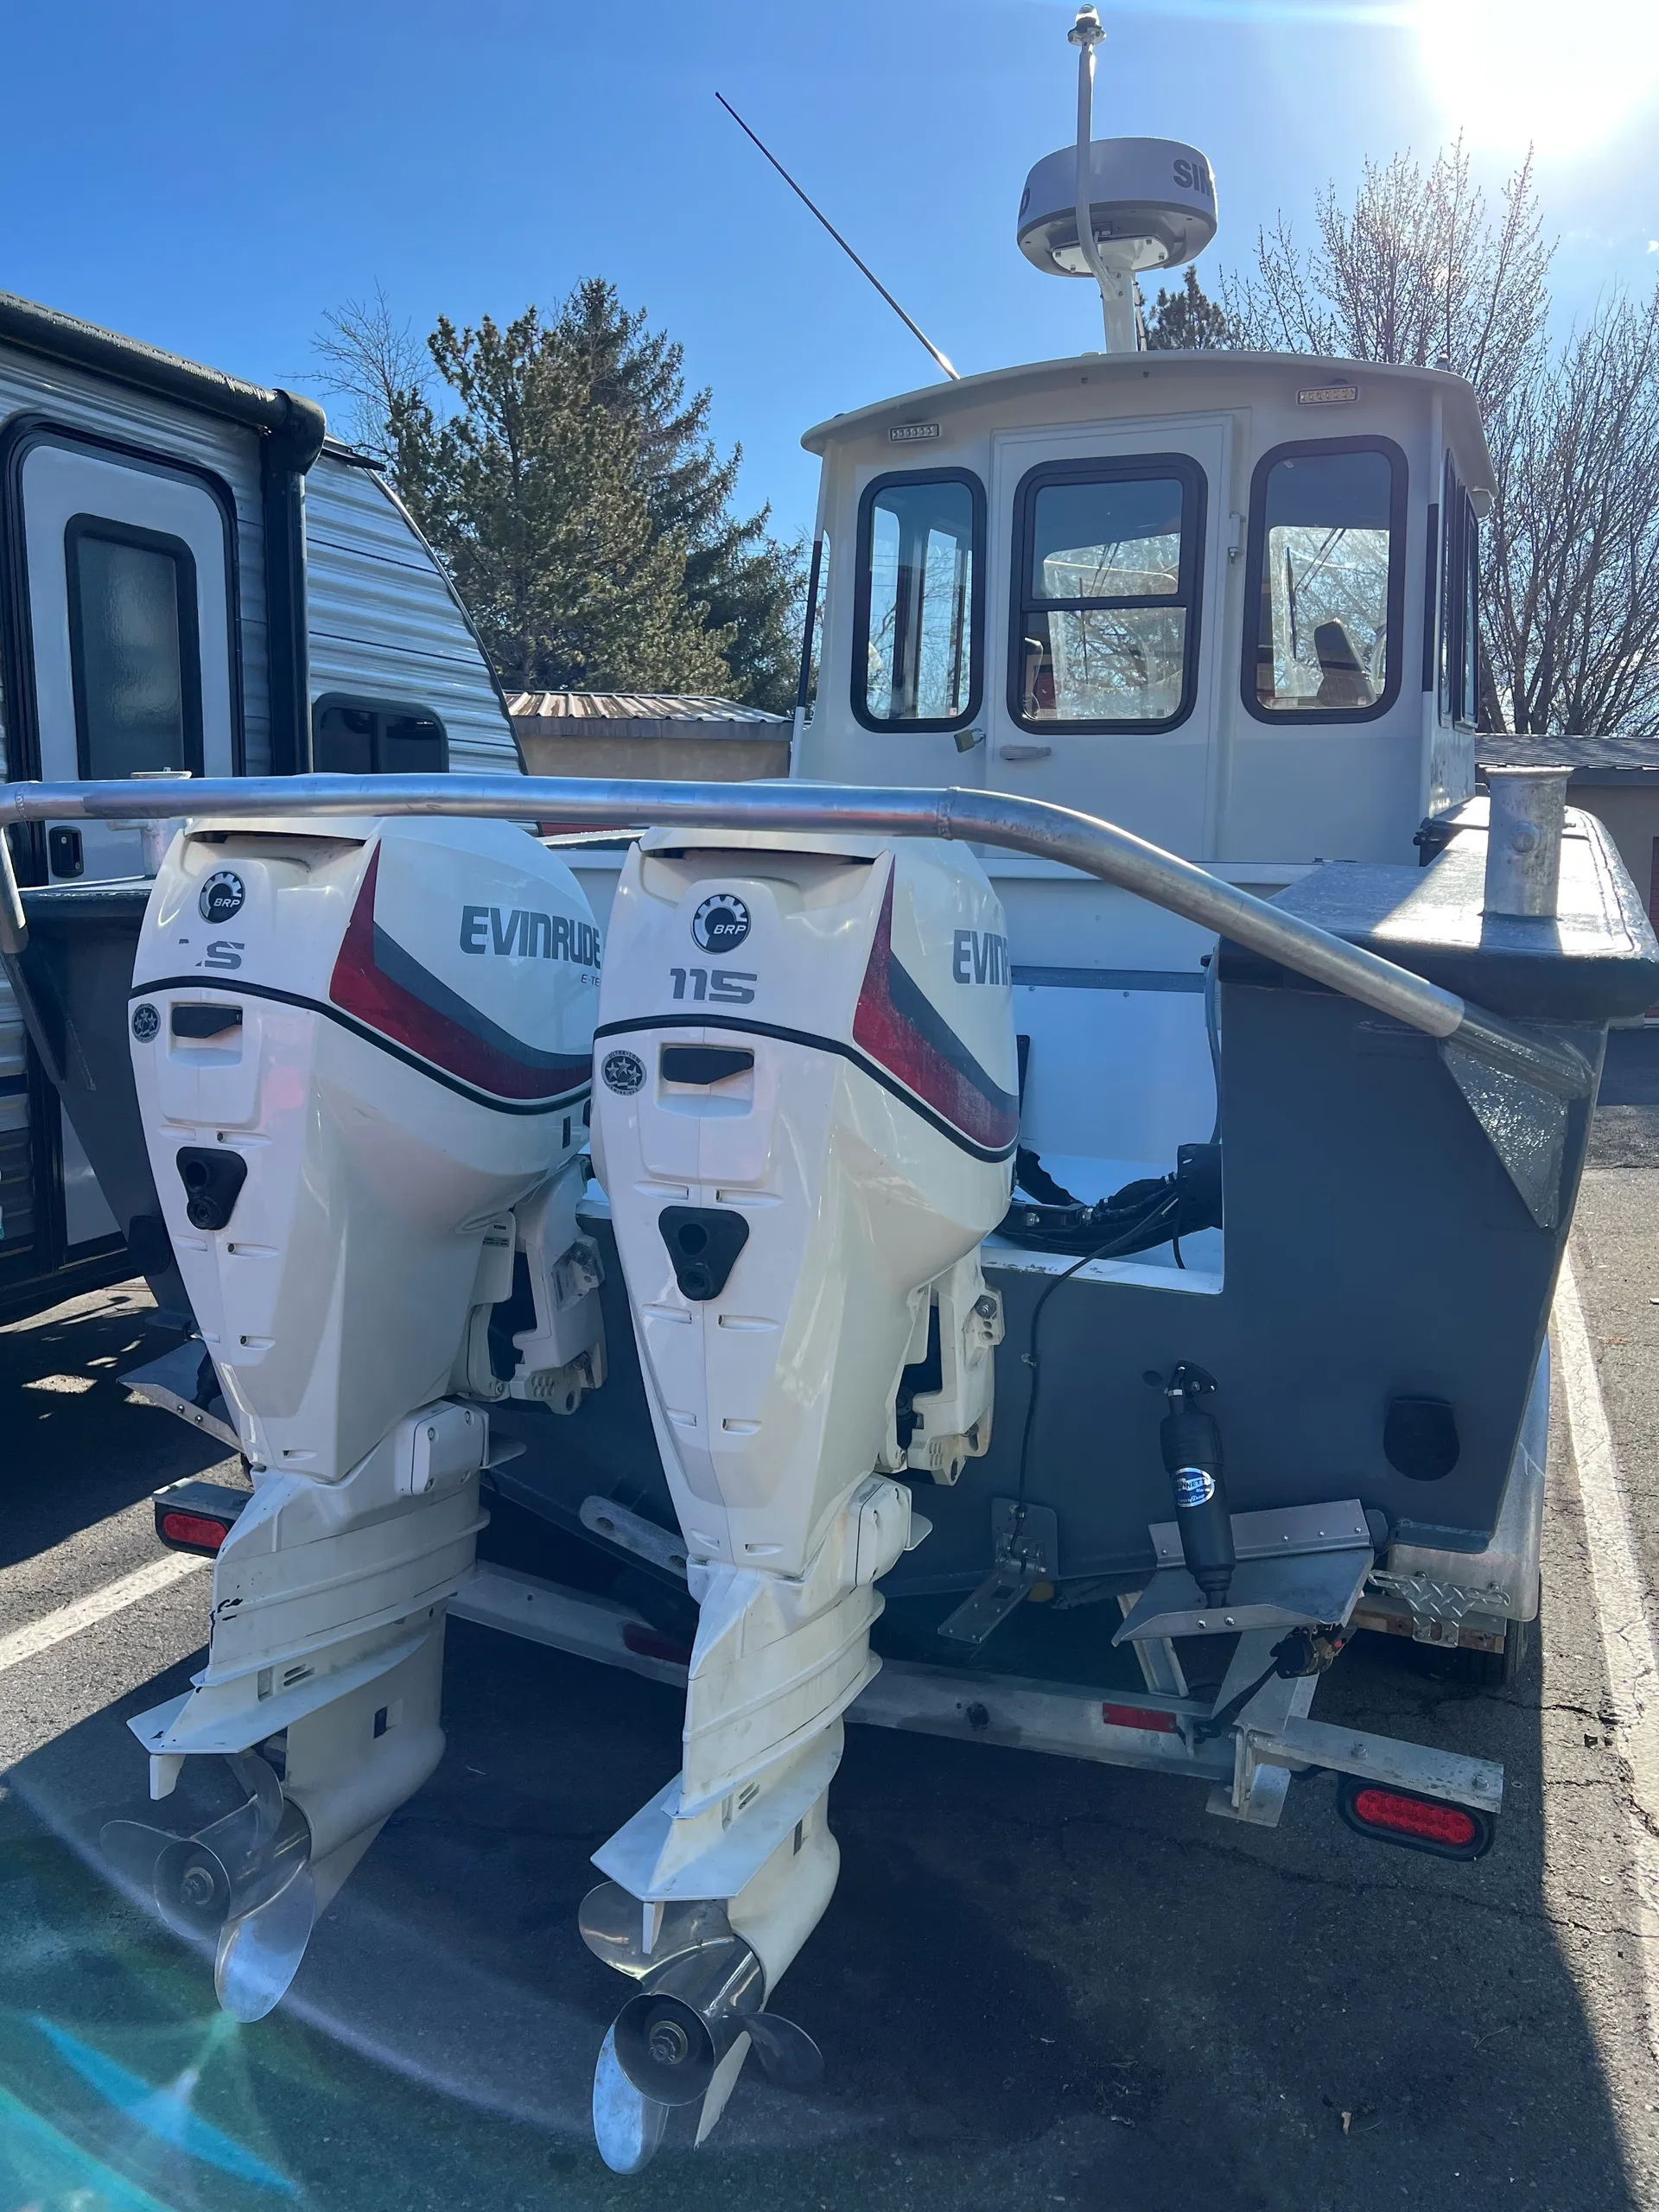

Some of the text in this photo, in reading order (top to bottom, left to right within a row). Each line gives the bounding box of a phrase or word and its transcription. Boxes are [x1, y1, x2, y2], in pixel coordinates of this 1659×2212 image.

[213, 898, 240, 908] BRP
[460, 906, 601, 969] EVINRUDE
[714, 925, 746, 935] BRP
[671, 968, 757, 1004] 115
